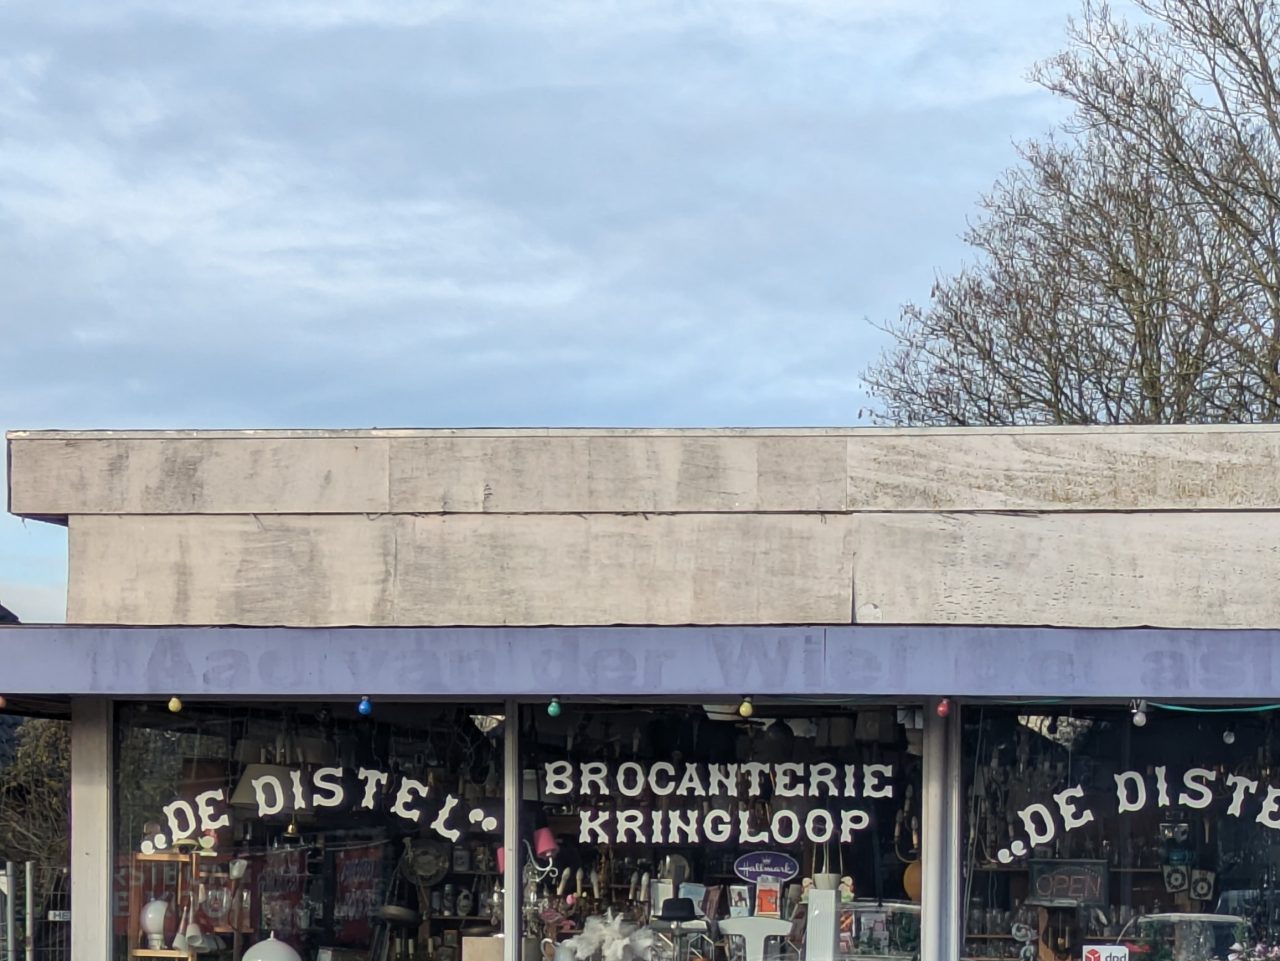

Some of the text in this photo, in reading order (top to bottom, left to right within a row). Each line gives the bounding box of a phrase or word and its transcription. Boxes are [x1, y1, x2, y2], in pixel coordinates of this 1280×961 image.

[544, 760, 894, 799] BROCANTERIE
[578, 808, 871, 845] KRINGLOOP
[737, 860, 795, 877] Hallmark
[1035, 873, 1101, 897] OPEN
